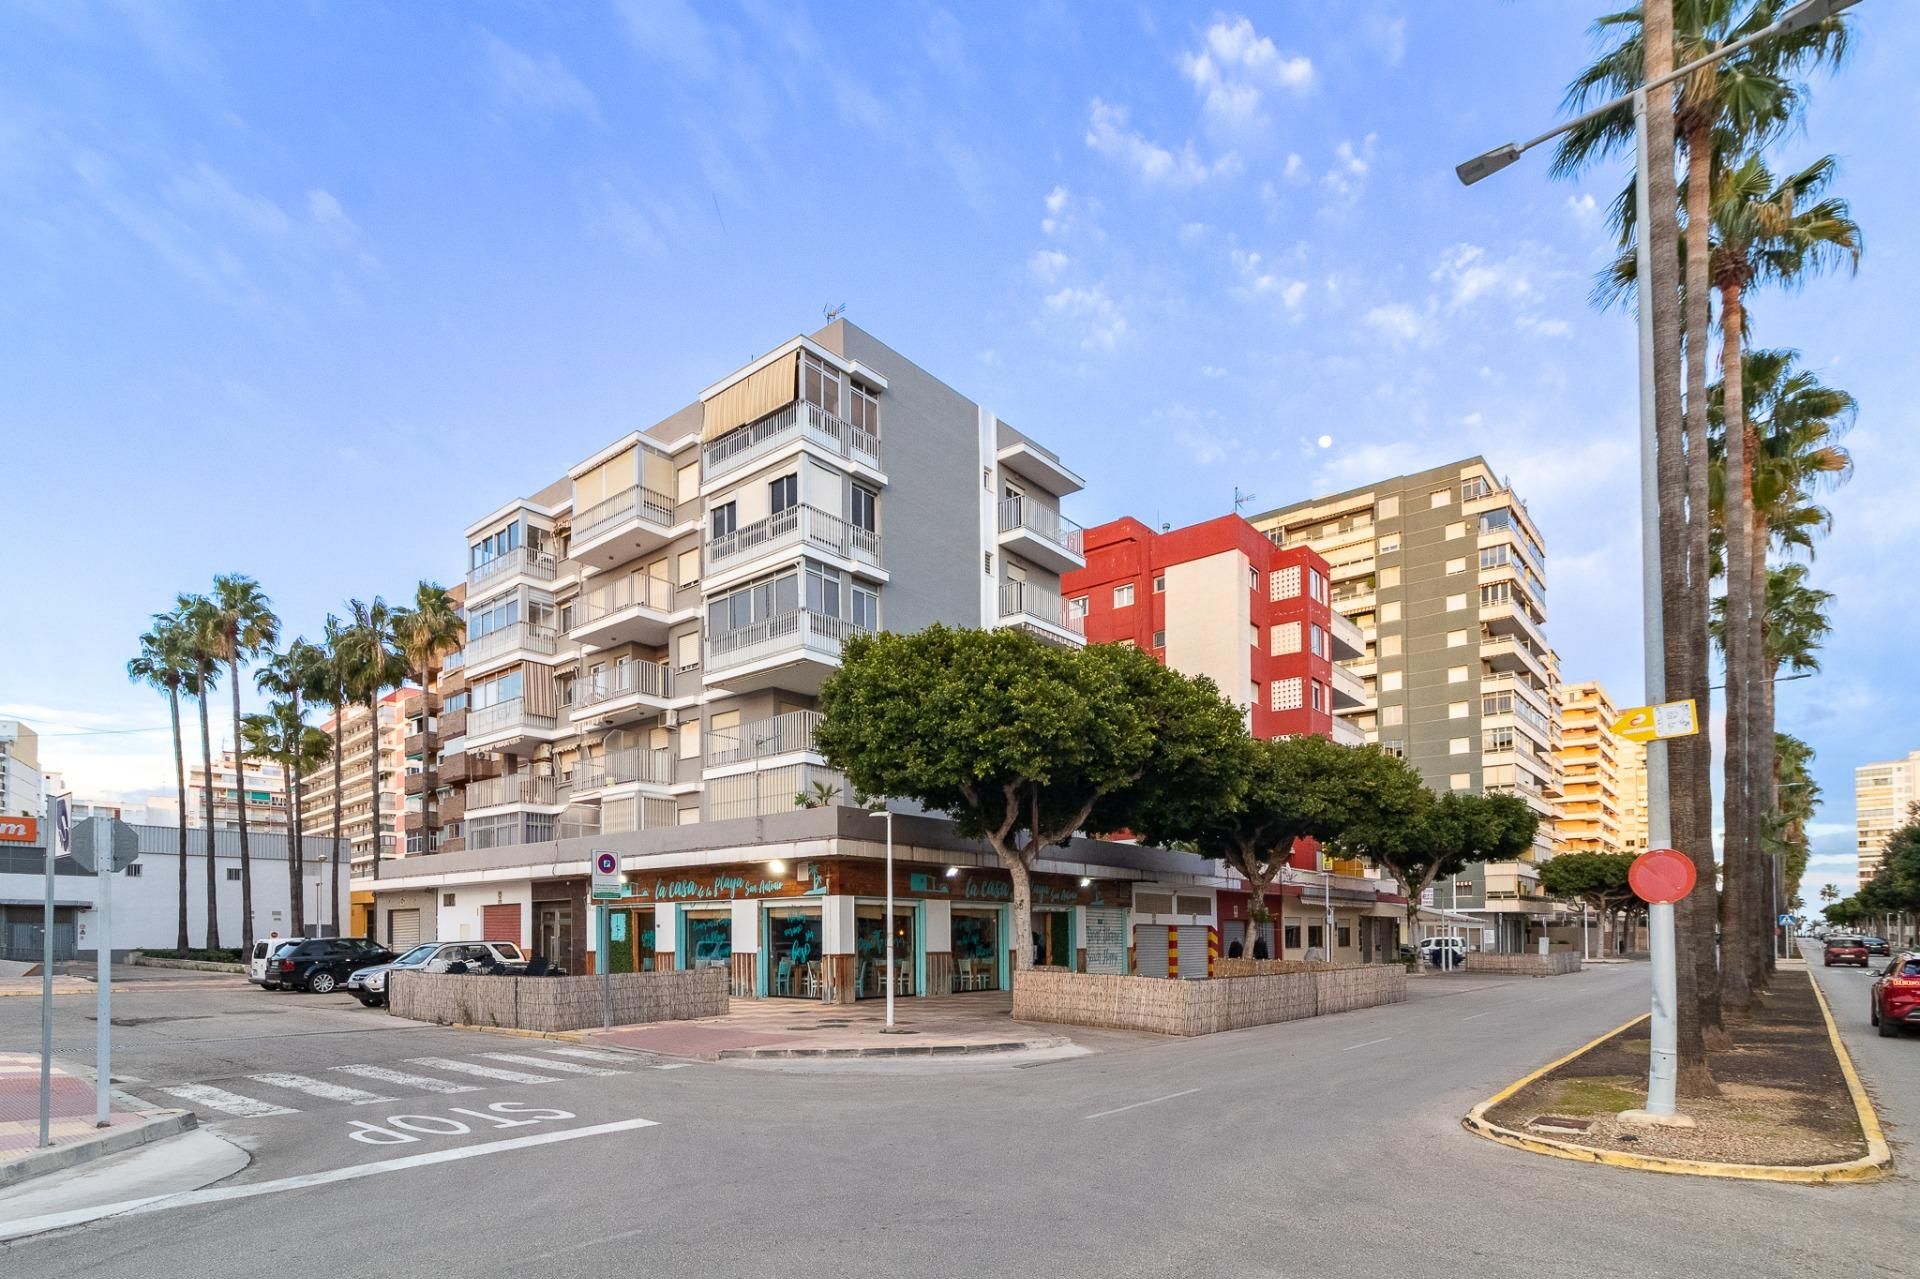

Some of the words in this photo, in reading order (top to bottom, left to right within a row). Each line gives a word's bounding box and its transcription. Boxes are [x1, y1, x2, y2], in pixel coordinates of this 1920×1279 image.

[744, 881, 757, 896] San
[758, 879, 784, 895] Antonio
[346, 1101, 576, 1145] STOP
